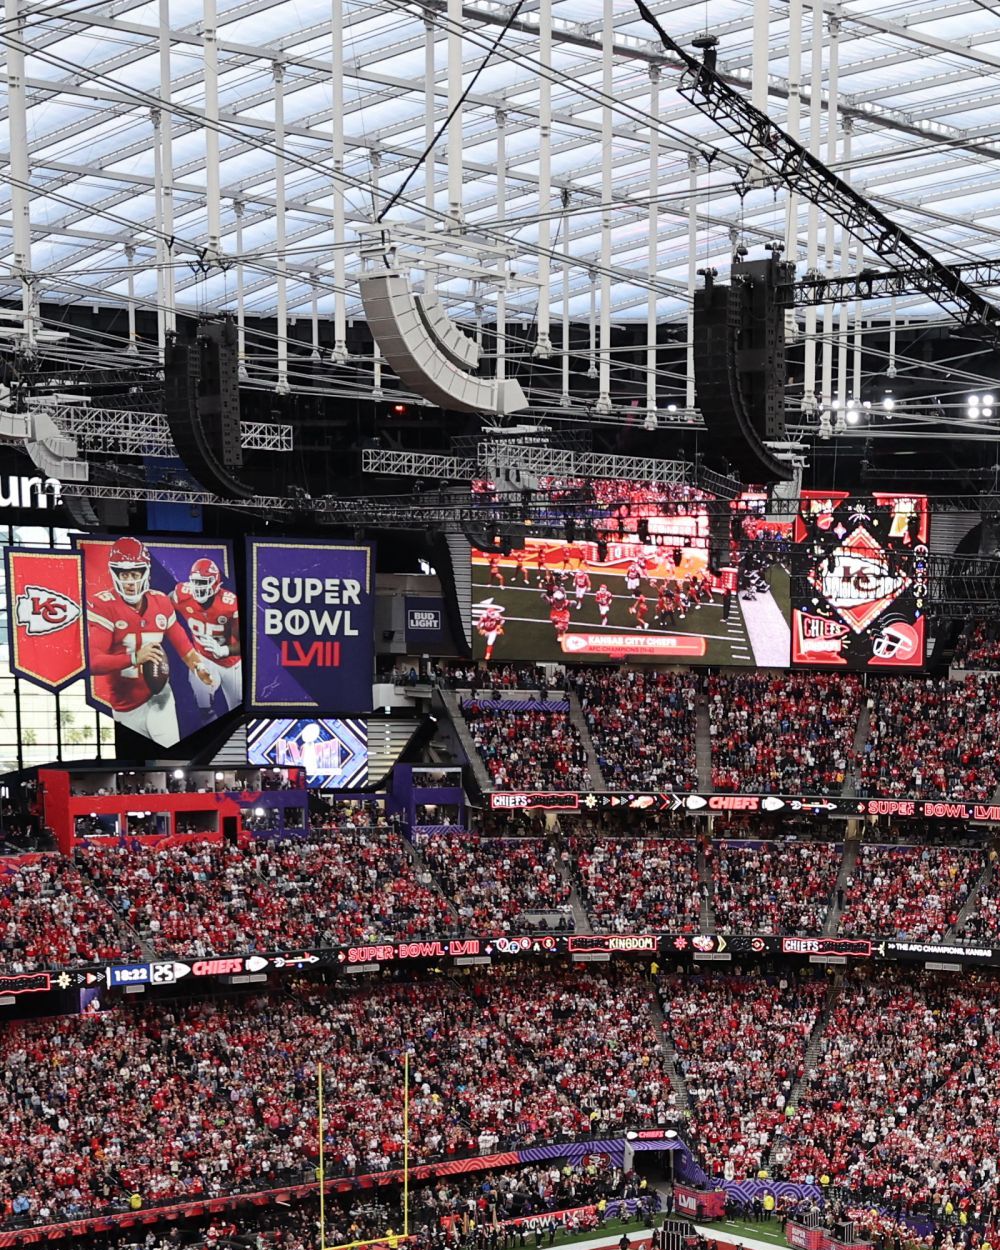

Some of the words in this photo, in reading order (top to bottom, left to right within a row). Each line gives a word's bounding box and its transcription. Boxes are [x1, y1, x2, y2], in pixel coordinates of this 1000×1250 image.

[261, 576, 361, 605] SUPER
[31, 597, 67, 623] KC
[414, 612, 435, 620] BUD
[264, 608, 359, 636] BOWL
[410, 619, 439, 628] LIGHT
[804, 618, 842, 639] CHIEFS
[588, 636, 625, 645] KANSAS
[626, 637, 645, 646] CITY
[646, 638, 677, 647] CHIEFS
[281, 640, 341, 667] LVIII
[493, 796, 528, 807] CHIEFS
[708, 796, 760, 810] CHIEFS
[924, 803, 969, 818] BOWL
[609, 938, 653, 949] KINGDOM
[785, 940, 819, 953] CHIEFS
[909, 944, 922, 952] AFC
[965, 947, 993, 957] KANSAS
[348, 945, 394, 963] SUPER
[399, 941, 446, 958] BOWL
[450, 940, 480, 954] LVIII
[192, 958, 243, 976] CHIEFS
[115, 968, 147, 982] 18:22
